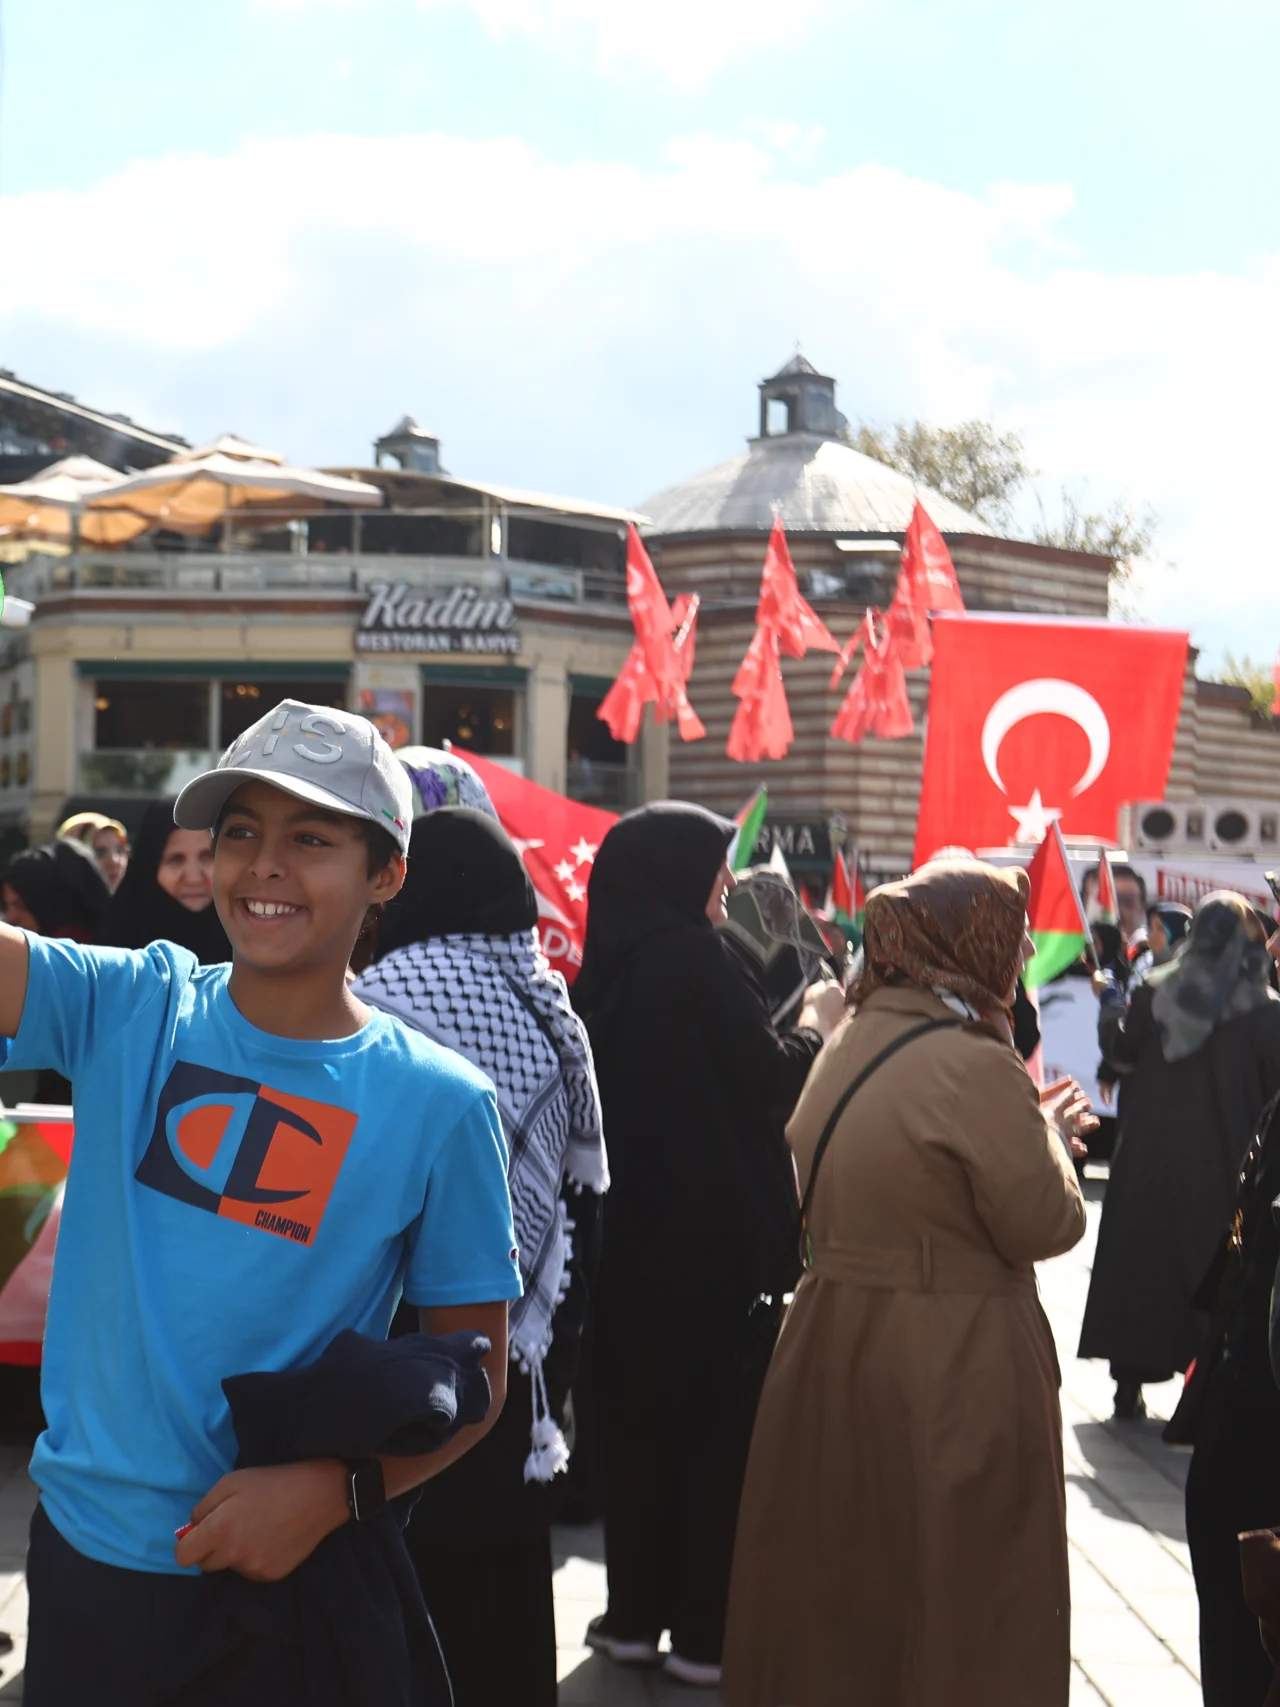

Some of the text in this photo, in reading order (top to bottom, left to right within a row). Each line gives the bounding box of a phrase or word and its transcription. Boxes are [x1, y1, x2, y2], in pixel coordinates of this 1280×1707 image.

[356, 632, 452, 652] RESTORAN
[461, 632, 522, 654] KAHVE
[254, 1209, 312, 1243] CHAMPION
